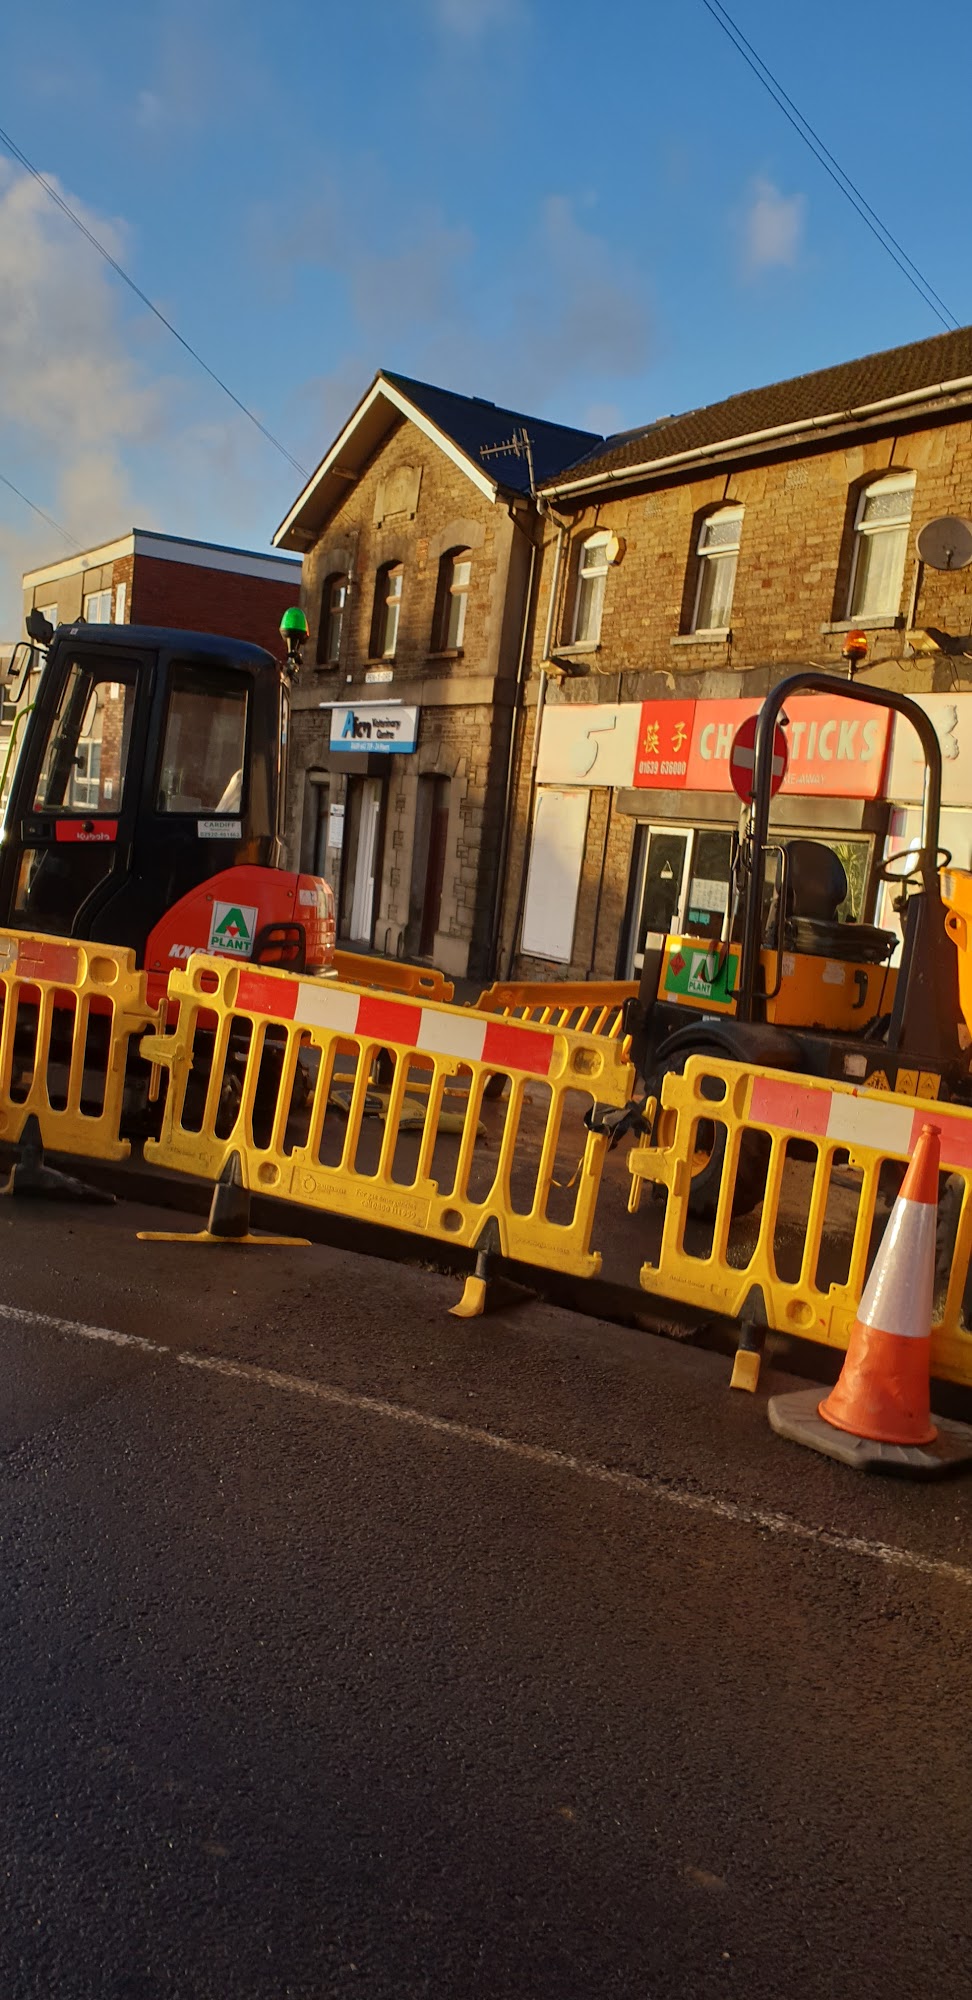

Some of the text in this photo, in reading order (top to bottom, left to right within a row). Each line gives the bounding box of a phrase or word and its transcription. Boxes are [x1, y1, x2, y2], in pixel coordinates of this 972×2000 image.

[700, 719, 880, 761] CHTICKS
[638, 760, 659, 775] 01639
[210, 936, 251, 951] PLANT
[688, 981, 711, 994] PLANT
